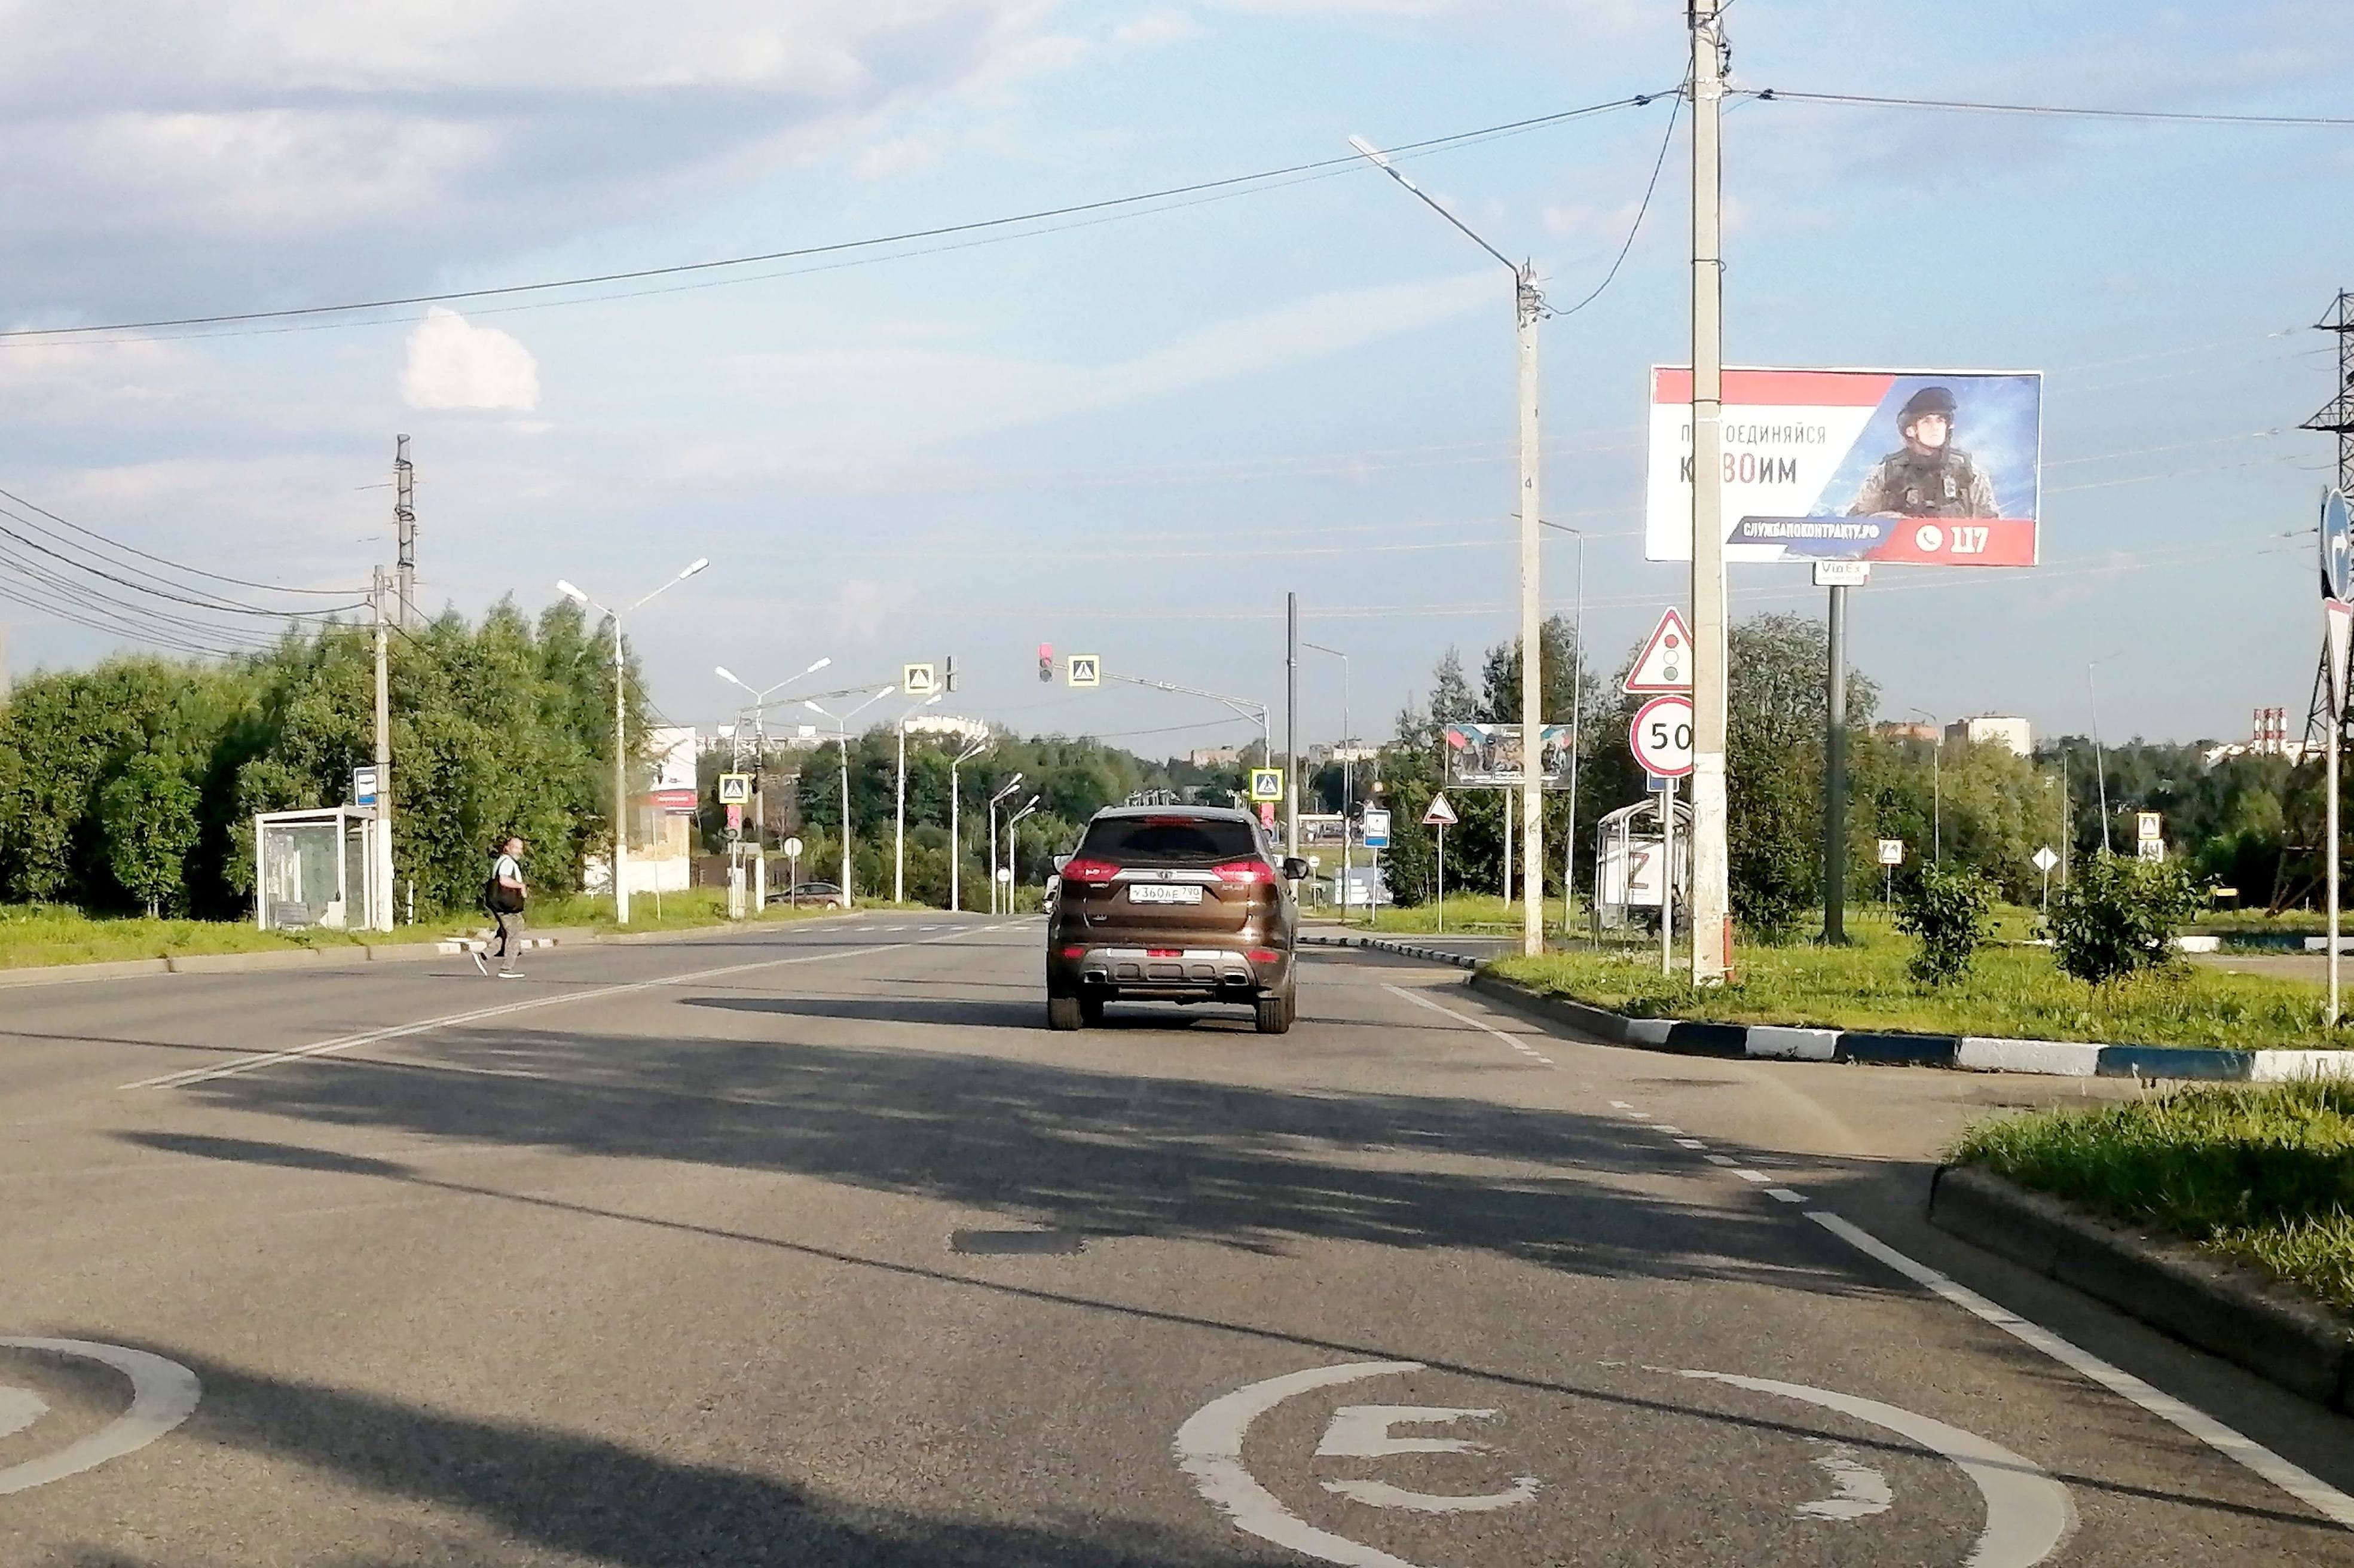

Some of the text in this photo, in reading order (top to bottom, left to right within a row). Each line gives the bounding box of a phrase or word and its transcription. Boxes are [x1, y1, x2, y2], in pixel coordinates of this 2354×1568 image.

[1682, 422, 1826, 445] ПОЕДИНЯЙСЯ
[1723, 453, 1796, 484] ВОИМ
[1950, 526, 1990, 554] 117
[1651, 723, 1693, 750] 50
